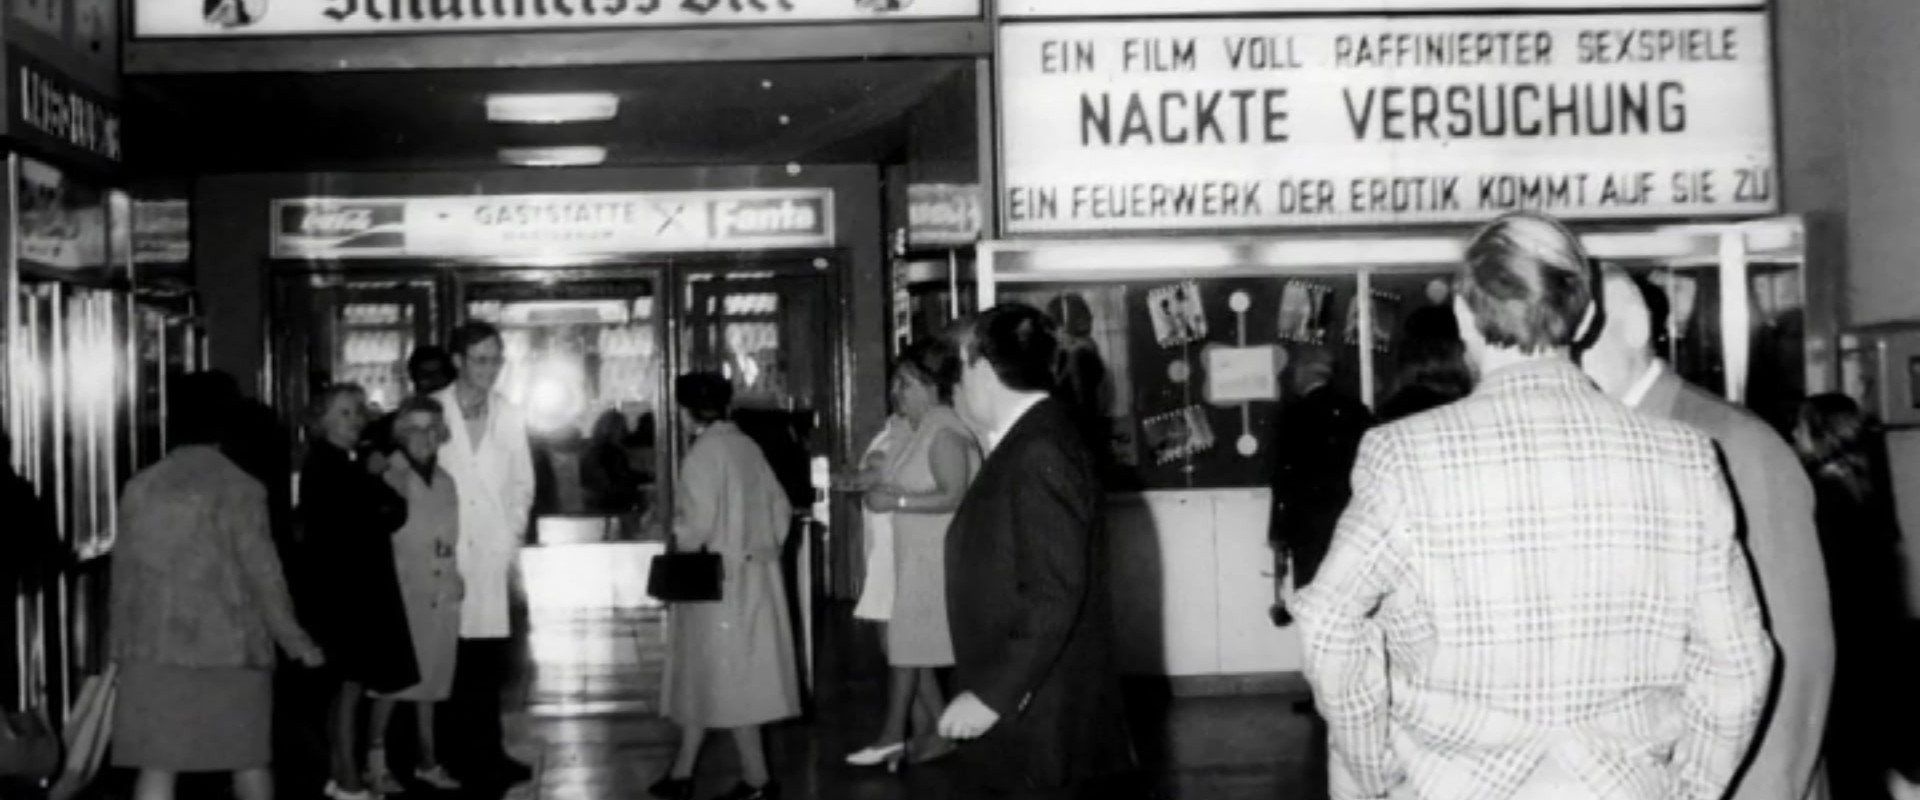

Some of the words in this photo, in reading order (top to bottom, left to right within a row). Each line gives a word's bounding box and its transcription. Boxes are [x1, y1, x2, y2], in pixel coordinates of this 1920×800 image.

[1042, 41, 1094, 73] EIN
[1124, 39, 1195, 71] FILM
[1226, 37, 1300, 69] VOLL
[1336, 30, 1552, 65] RAFFINIERTER
[1578, 27, 1736, 63] SEXSPIELE
[1080, 89, 1288, 146] NACKTE
[1344, 81, 1686, 140] VERSUCHUNG
[1010, 187, 1057, 220] EIN
[1072, 183, 1261, 218] FEUERWERK
[1279, 180, 1334, 214] DER
[1351, 178, 1459, 214] EROTIK
[1479, 175, 1586, 210] KOMMT
[1599, 172, 1653, 206] AUF
[1672, 170, 1716, 205] SIE
[1734, 168, 1770, 204] ZU
